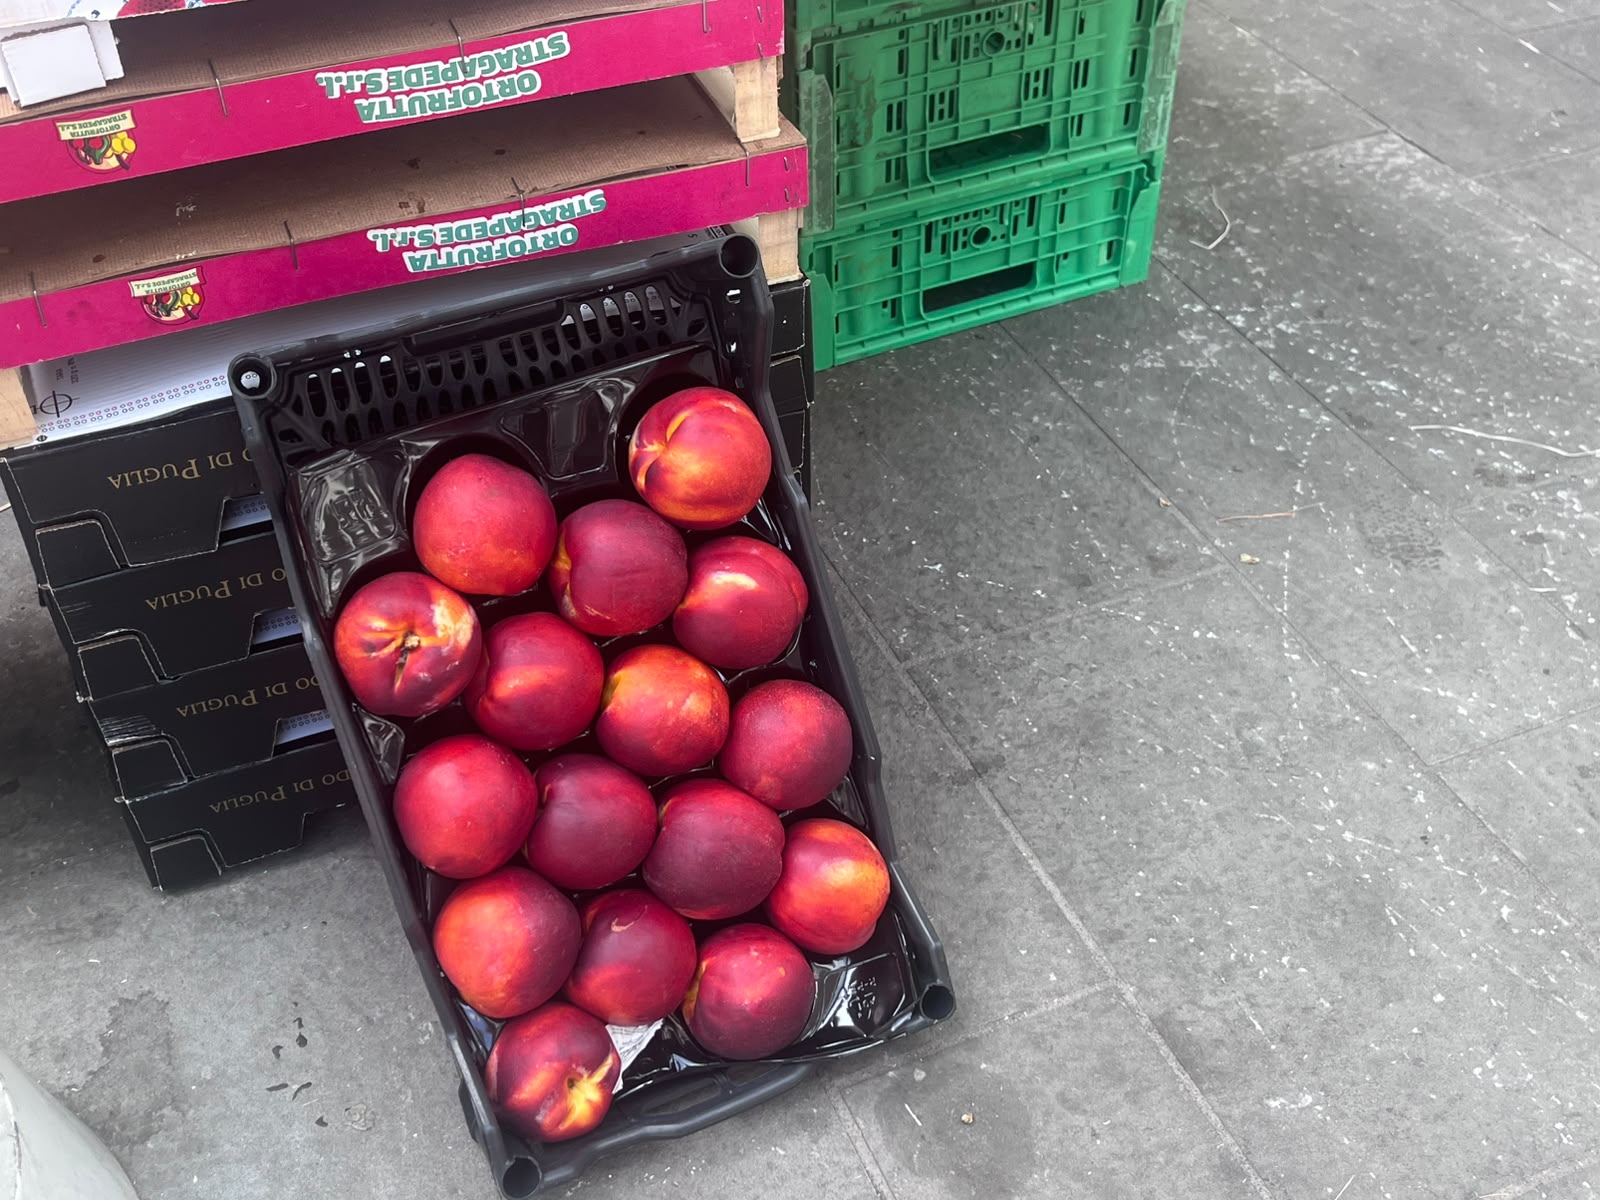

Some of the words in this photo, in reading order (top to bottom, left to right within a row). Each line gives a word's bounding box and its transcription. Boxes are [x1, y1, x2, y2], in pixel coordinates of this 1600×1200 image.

[387, 33, 569, 91] STRAGAPEDE
[316, 72, 384, 97] S.r.l.
[355, 72, 540, 122] ORTOFRUTTA
[70, 123, 121, 138] ORTOFRUTTA
[78, 113, 128, 129] STRAGAPEDE
[440, 192, 607, 245] STRAGAPEDE
[371, 229, 435, 251] S.r.l.
[407, 227, 579, 272] ORTOFRUTTA
[145, 281, 191, 294] ORTOFRUTTA
[152, 271, 197, 287] STRAGAPEDE
[207, 451, 234, 470] DI
[107, 458, 201, 489] PUGLIA
[239, 572, 264, 590] DI
[145, 579, 233, 610] PUGLIA
[264, 682, 289, 698] DI
[176, 689, 259, 718] PUGLIA
[292, 778, 315, 793] DI
